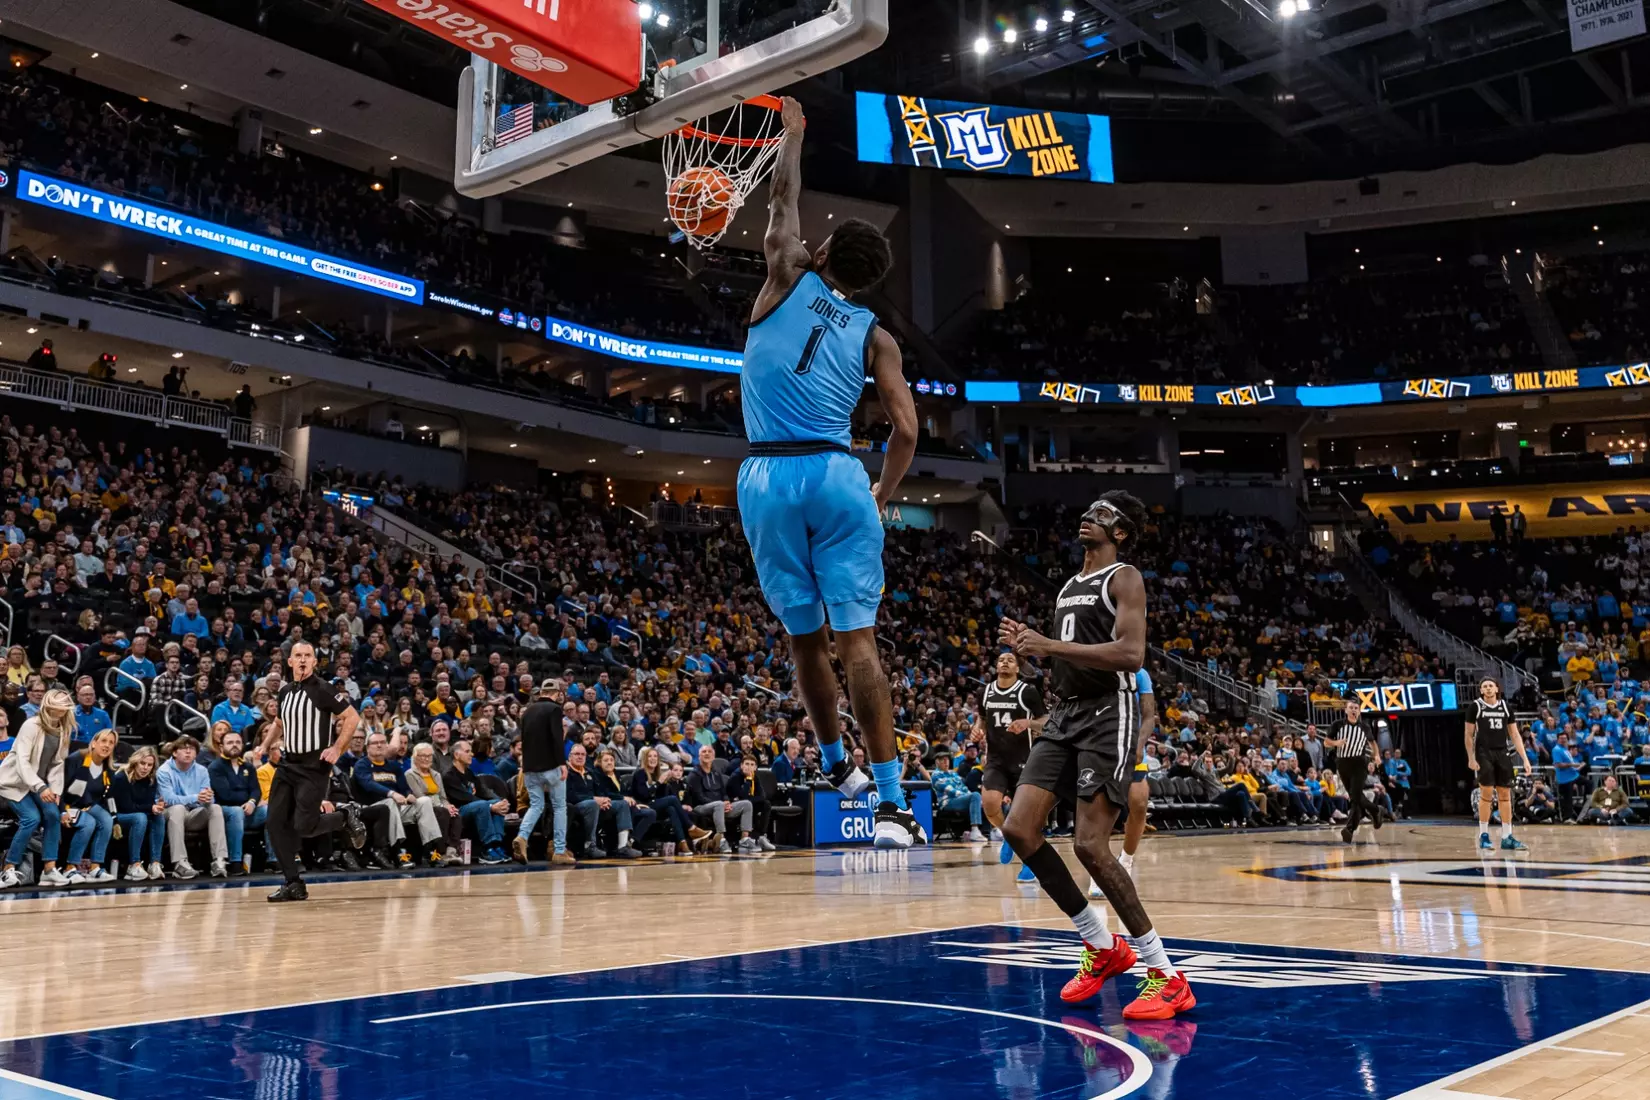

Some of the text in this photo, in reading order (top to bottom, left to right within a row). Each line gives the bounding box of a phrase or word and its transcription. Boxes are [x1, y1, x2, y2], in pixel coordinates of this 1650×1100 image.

[1575, 0, 1634, 17] CHAMPIO
[396, 0, 513, 50] State
[1006, 111, 1063, 150] KILL
[1027, 145, 1080, 177] ZONE
[108, 201, 183, 236] WRECK
[185, 225, 193, 234] A
[194, 228, 226, 243] GREAT
[226, 236, 249, 250] TIME
[249, 243, 261, 252] AT
[262, 246, 279, 258] THE
[315, 262, 328, 270] GET
[330, 265, 341, 274] THE
[342, 269, 357, 278] FREE
[358, 273, 377, 284] DRIVE
[378, 279, 398, 289] SOBER
[807, 296, 851, 329] JONES
[599, 336, 648, 359] WRECK
[656, 350, 681, 359] GREAT
[681, 352, 699, 361] TIME
[710, 356, 723, 364] THE
[724, 358, 743, 367] GAM
[793, 325, 828, 376] 1
[1514, 372, 1542, 390] KILL
[1544, 368, 1579, 388] ZONE
[1138, 384, 1163, 402] KILL
[1164, 385, 1194, 402] ZONE
[1389, 500, 1510, 524] WE
[1061, 613, 1075, 642] 0
[992, 712, 1013, 727] 14
[1489, 718, 1503, 729] 13
[841, 801, 868, 809] ONE CALL
[841, 817, 876, 839] GRU
